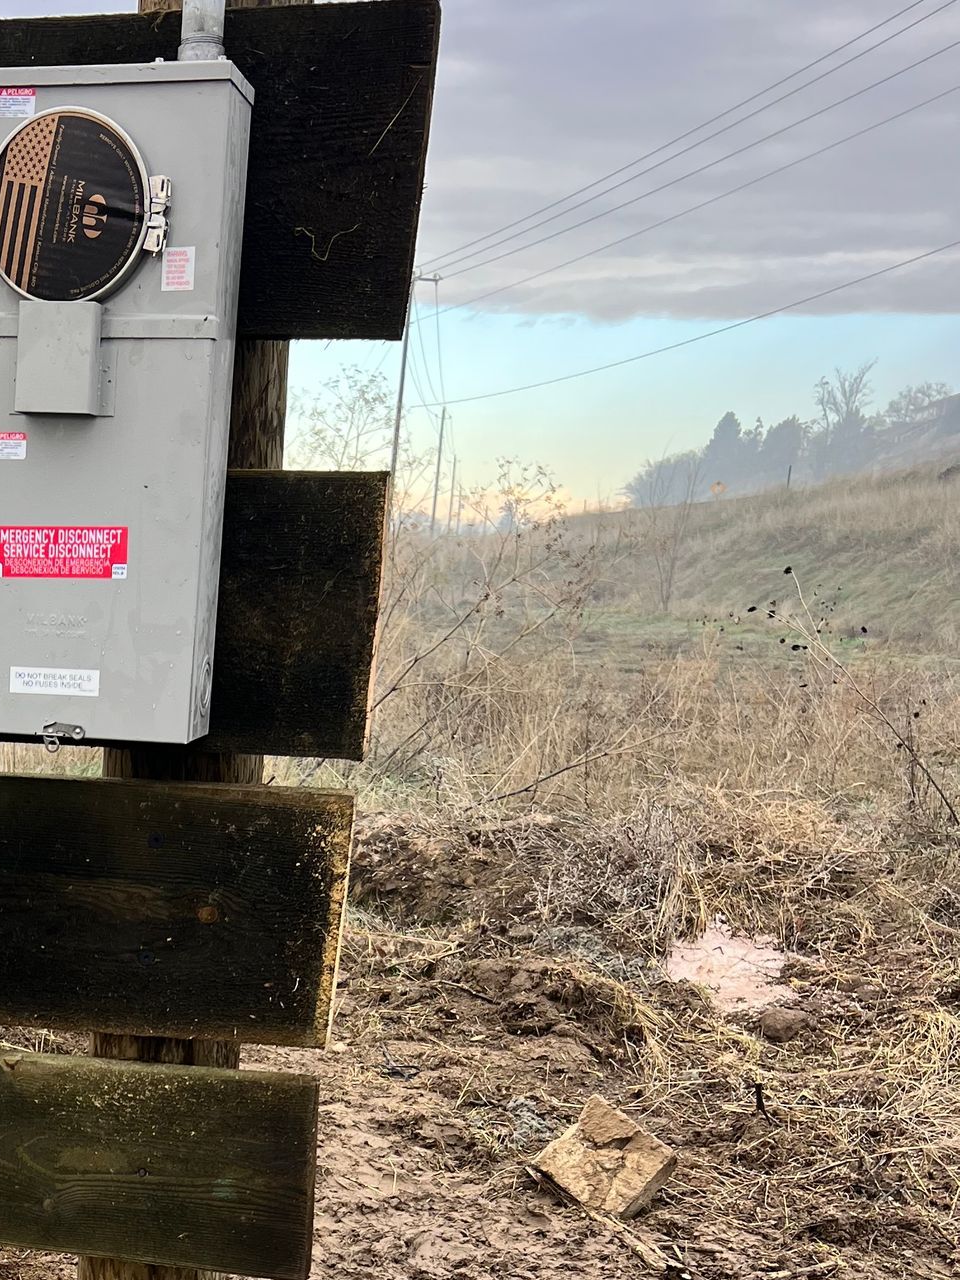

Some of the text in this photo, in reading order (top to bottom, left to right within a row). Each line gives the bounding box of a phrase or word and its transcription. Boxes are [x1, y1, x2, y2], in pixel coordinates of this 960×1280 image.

[8, 88, 33, 96] PELIGRO
[99, 132, 116, 150] REMOVE
[67, 180, 85, 243] MILBANK
[58, 529, 122, 544] DISCONNECT
[3, 544, 112, 558] SERVICE DISCONNECT
[66, 559, 111, 567] EMERGENCIA
[72, 567, 104, 575] SERVICIO
[27, 672, 42, 680] NOT
[43, 673, 68, 681] BREAK
[35, 680, 58, 688] FUSES
